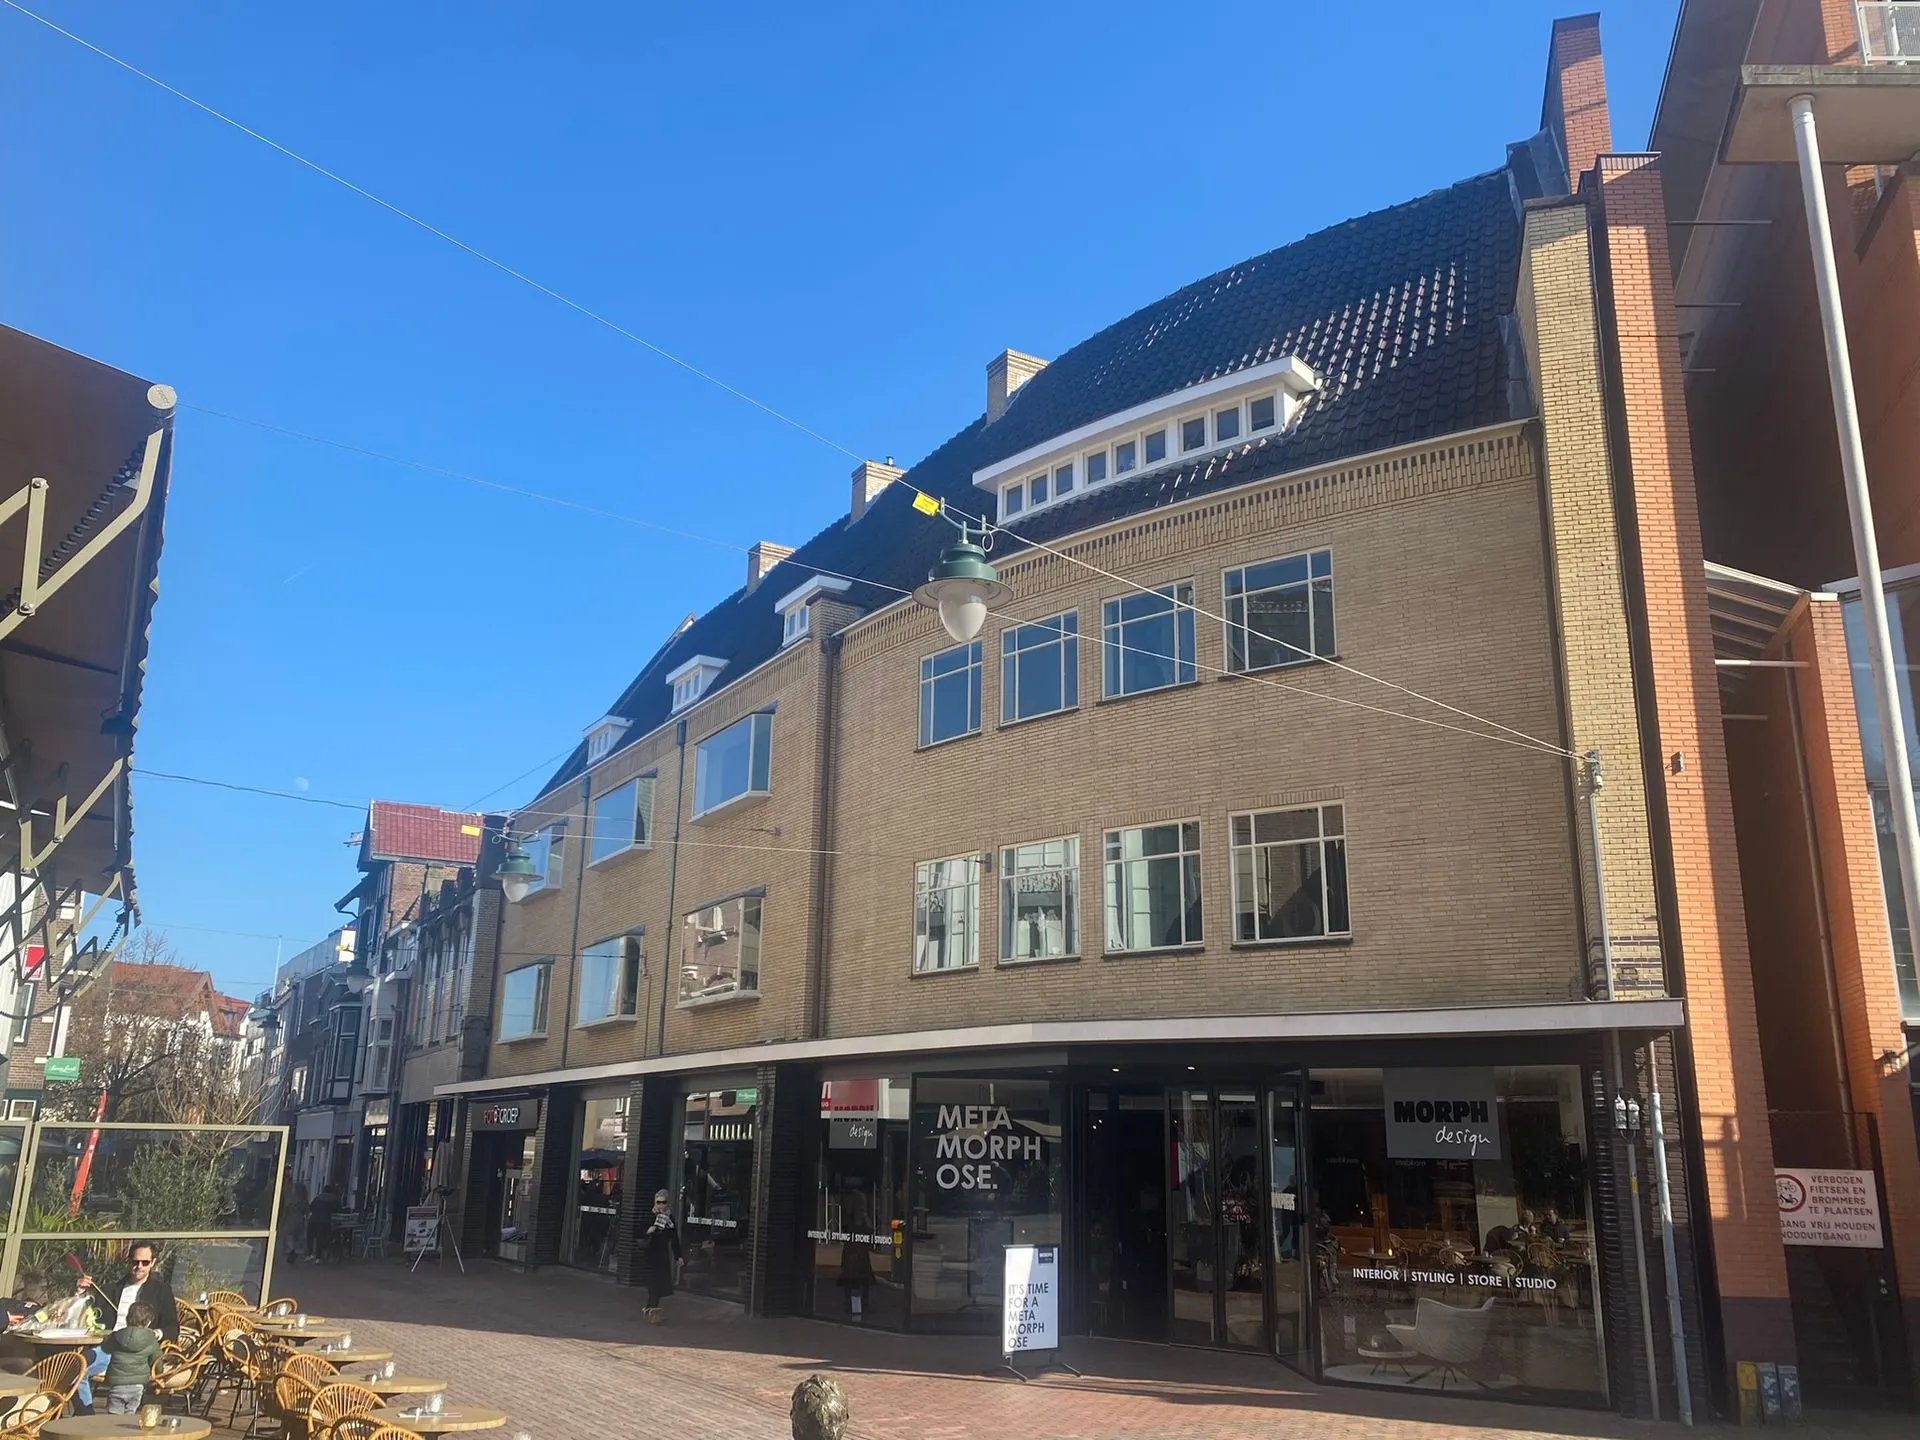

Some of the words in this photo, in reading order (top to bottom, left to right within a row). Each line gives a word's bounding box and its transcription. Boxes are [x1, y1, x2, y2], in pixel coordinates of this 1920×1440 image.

[936, 1105, 1013, 1130] META
[1394, 1101, 1489, 1123] MORPH
[849, 1124, 874, 1146] design
[1435, 1126, 1491, 1156] design
[936, 1134, 1041, 1160] MORPH
[936, 1164, 998, 1190] OSE.
[1810, 1175, 1863, 1185] VERBODEN
[1809, 1185, 1849, 1195] FIETSEN
[1853, 1186, 1866, 1195] EN
[1812, 1196, 1866, 1206] BROMMERS
[1808, 1206, 1820, 1215] TE
[1824, 1207, 1873, 1216] PLAATSEN
[1810, 1220, 1831, 1230] VRIJ
[1835, 1221, 1876, 1232] HOUDEN
[807, 1230, 828, 1240] INTERIOR
[831, 1231, 850, 1242] STYLING
[855, 1233, 870, 1243] STORE
[874, 1235, 893, 1245] STUDIO
[1353, 1268, 1400, 1281] INTERIOR
[1411, 1271, 1455, 1284] STYLING
[1468, 1274, 1502, 1287] STORE
[1515, 1277, 1557, 1290] STUDIO
[1008, 1283, 1025, 1295] IT'S
[1028, 1282, 1049, 1294] TIME
[1008, 1296, 1028, 1308] FOR
[1031, 1296, 1039, 1308] A
[1008, 1310, 1036, 1322] META
[1008, 1322, 1045, 1335] MORPH
[1008, 1336, 1028, 1349] OSE
